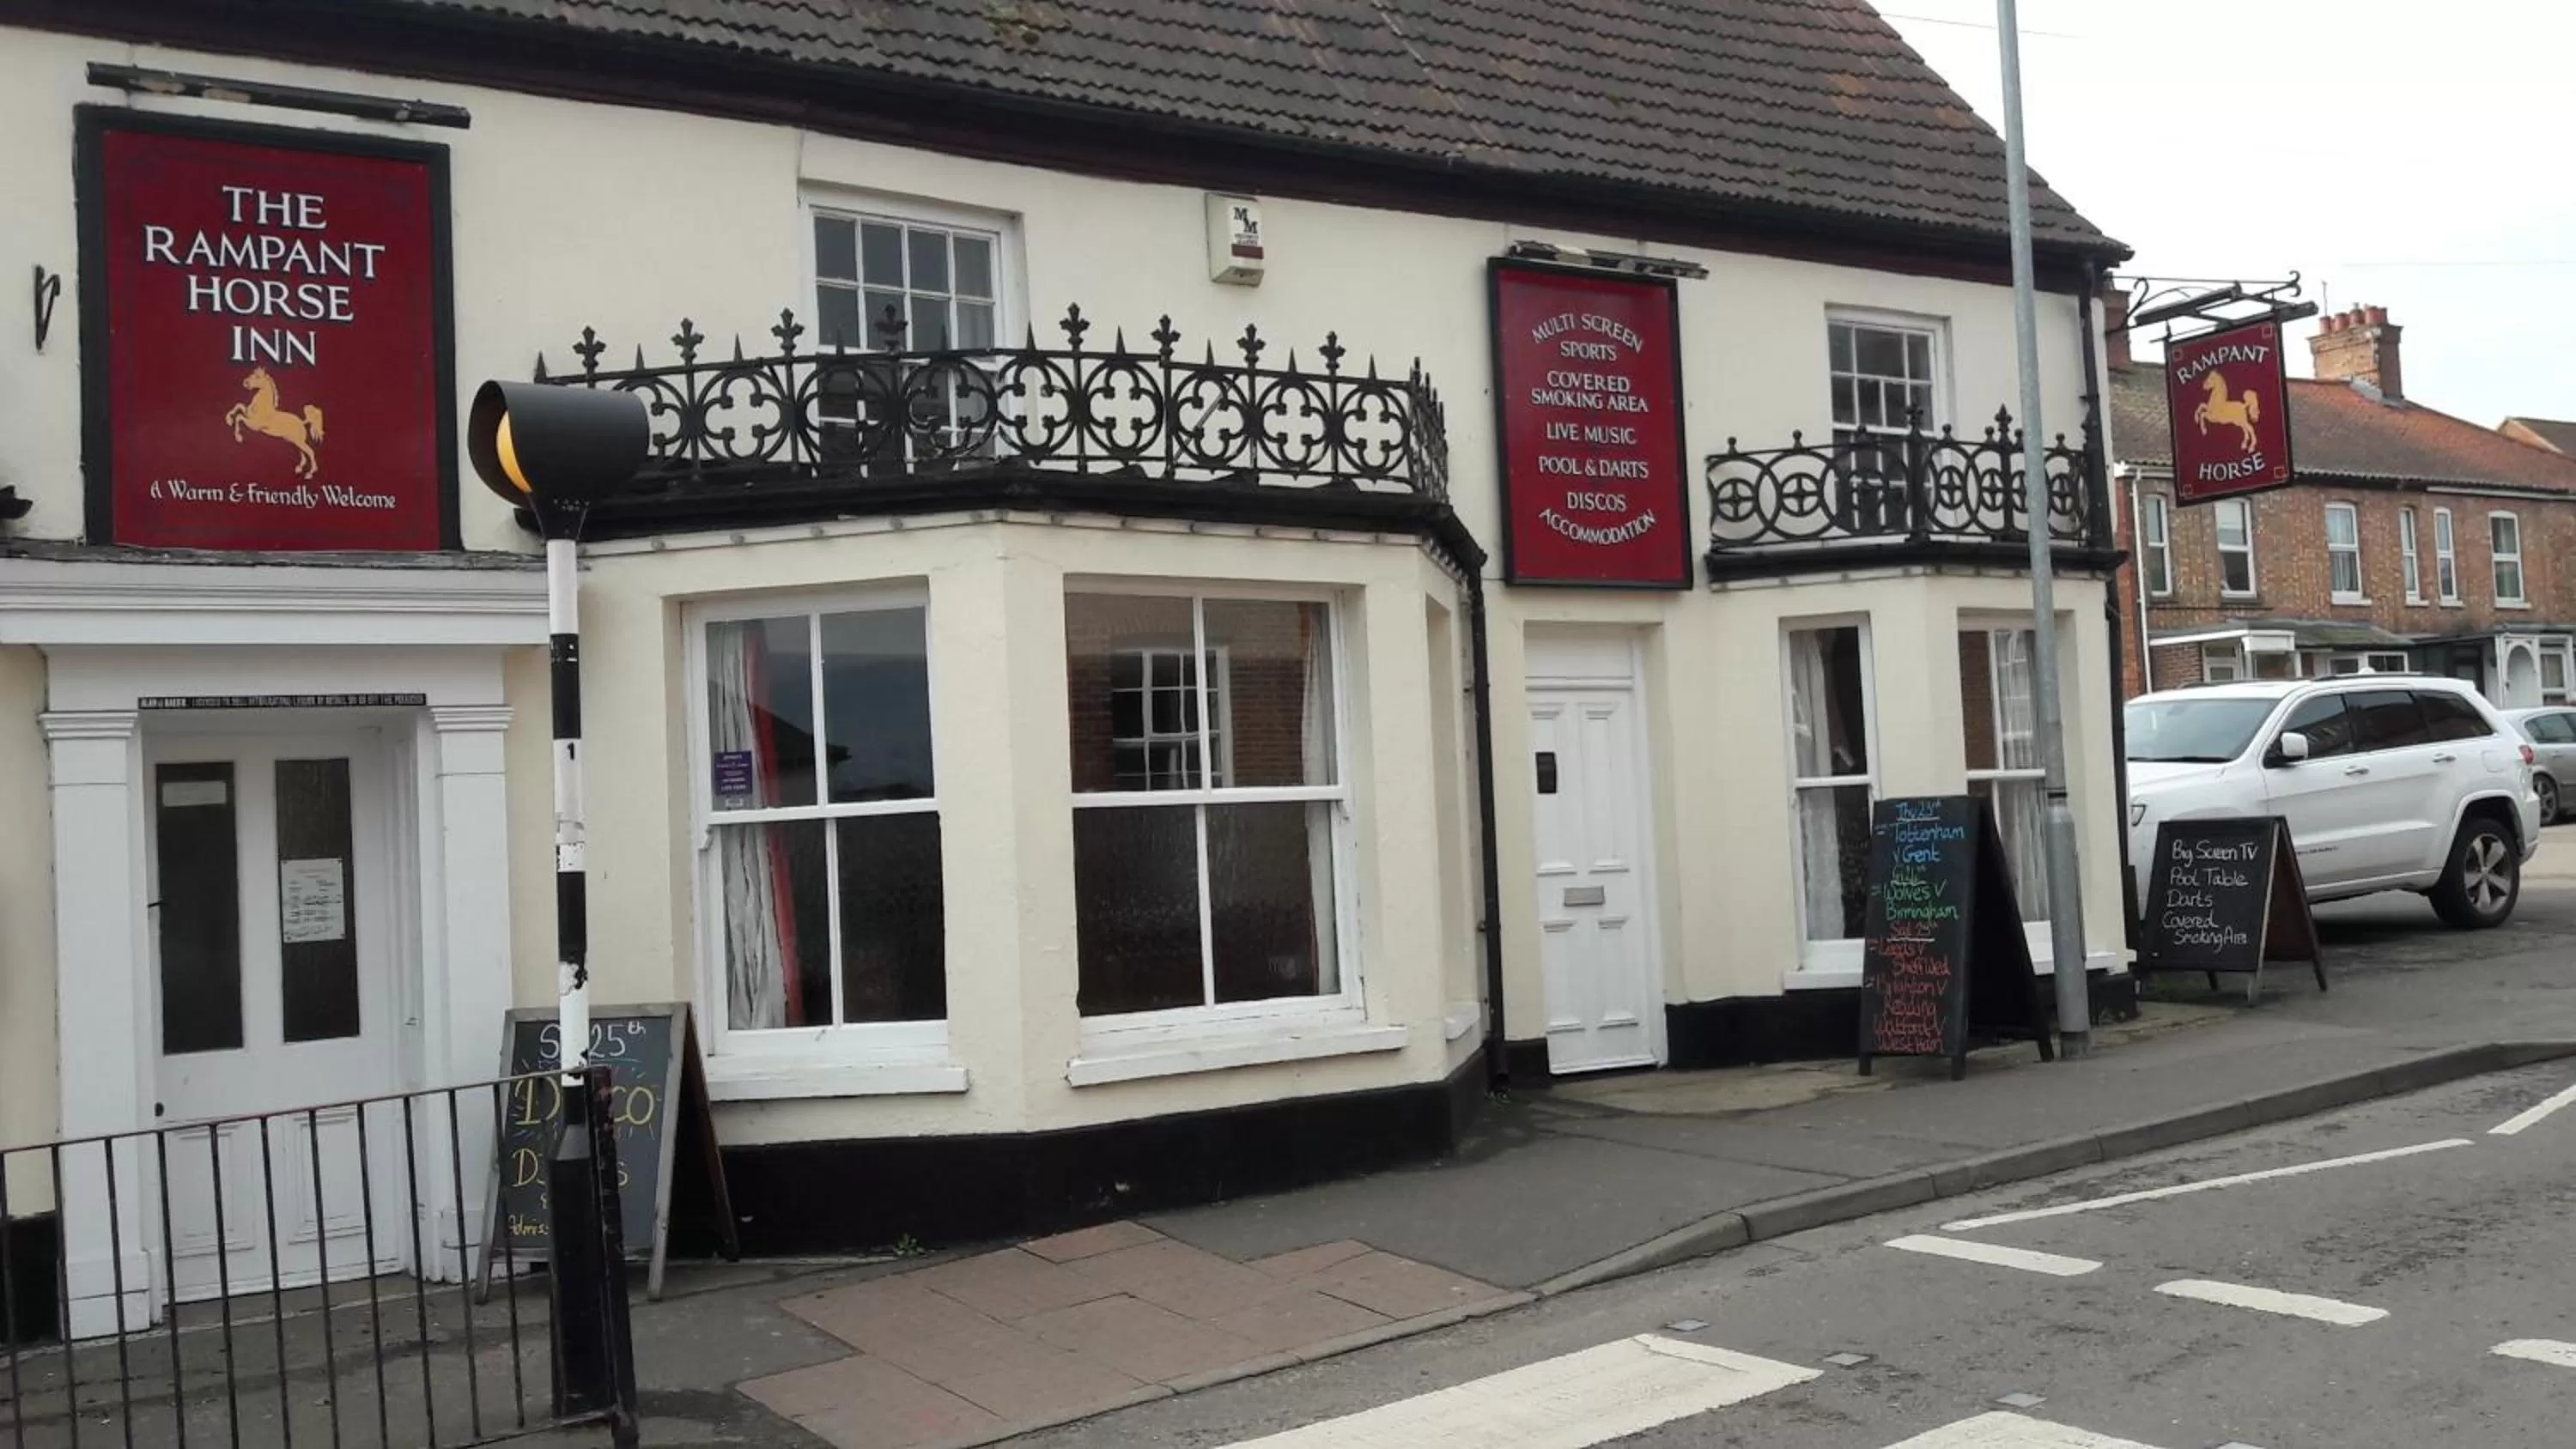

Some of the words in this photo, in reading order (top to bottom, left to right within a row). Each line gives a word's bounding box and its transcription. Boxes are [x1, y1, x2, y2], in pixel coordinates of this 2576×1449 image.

[222, 185, 327, 229] THE
[144, 225, 386, 279] RAMPANT
[187, 274, 354, 321] HORSE
[232, 324, 317, 367] INN
[1532, 312, 1576, 343] MULTI
[1581, 313, 1643, 354] SCREEN
[1560, 341, 1618, 361] SPORTS
[2176, 344, 2269, 385] RAMPANT
[1547, 371, 1631, 393] COVERED
[1531, 388, 1604, 409] SMOKING
[1607, 395, 1649, 413] AREA
[1546, 421, 1580, 440] LIVE
[1584, 426, 1637, 446] MUSIC
[1538, 456, 1583, 476] POOL
[1585, 458, 1599, 477] &
[1599, 459, 1649, 479] DARTS
[2198, 452, 2266, 482] HORSE
[150, 480, 163, 499] A
[167, 479, 224, 502] Warm
[228, 482, 244, 503] &
[247, 483, 319, 509] Friendly
[322, 485, 397, 509] Welcome
[1567, 491, 1627, 512] DISCOS
[1539, 508, 1656, 545] ACCOMMODATION
[1902, 843, 1941, 864] Gent
[2172, 838, 2194, 867] Big
[2196, 840, 2239, 860] Screen
[2239, 841, 2258, 861] TV
[2170, 865, 2200, 886] Pool
[2203, 867, 2249, 887] Table
[2166, 888, 2214, 908] Darts
[2161, 910, 2219, 929] Covered
[2173, 928, 2223, 954] Smoking
[589, 1021, 647, 1058] 25th
